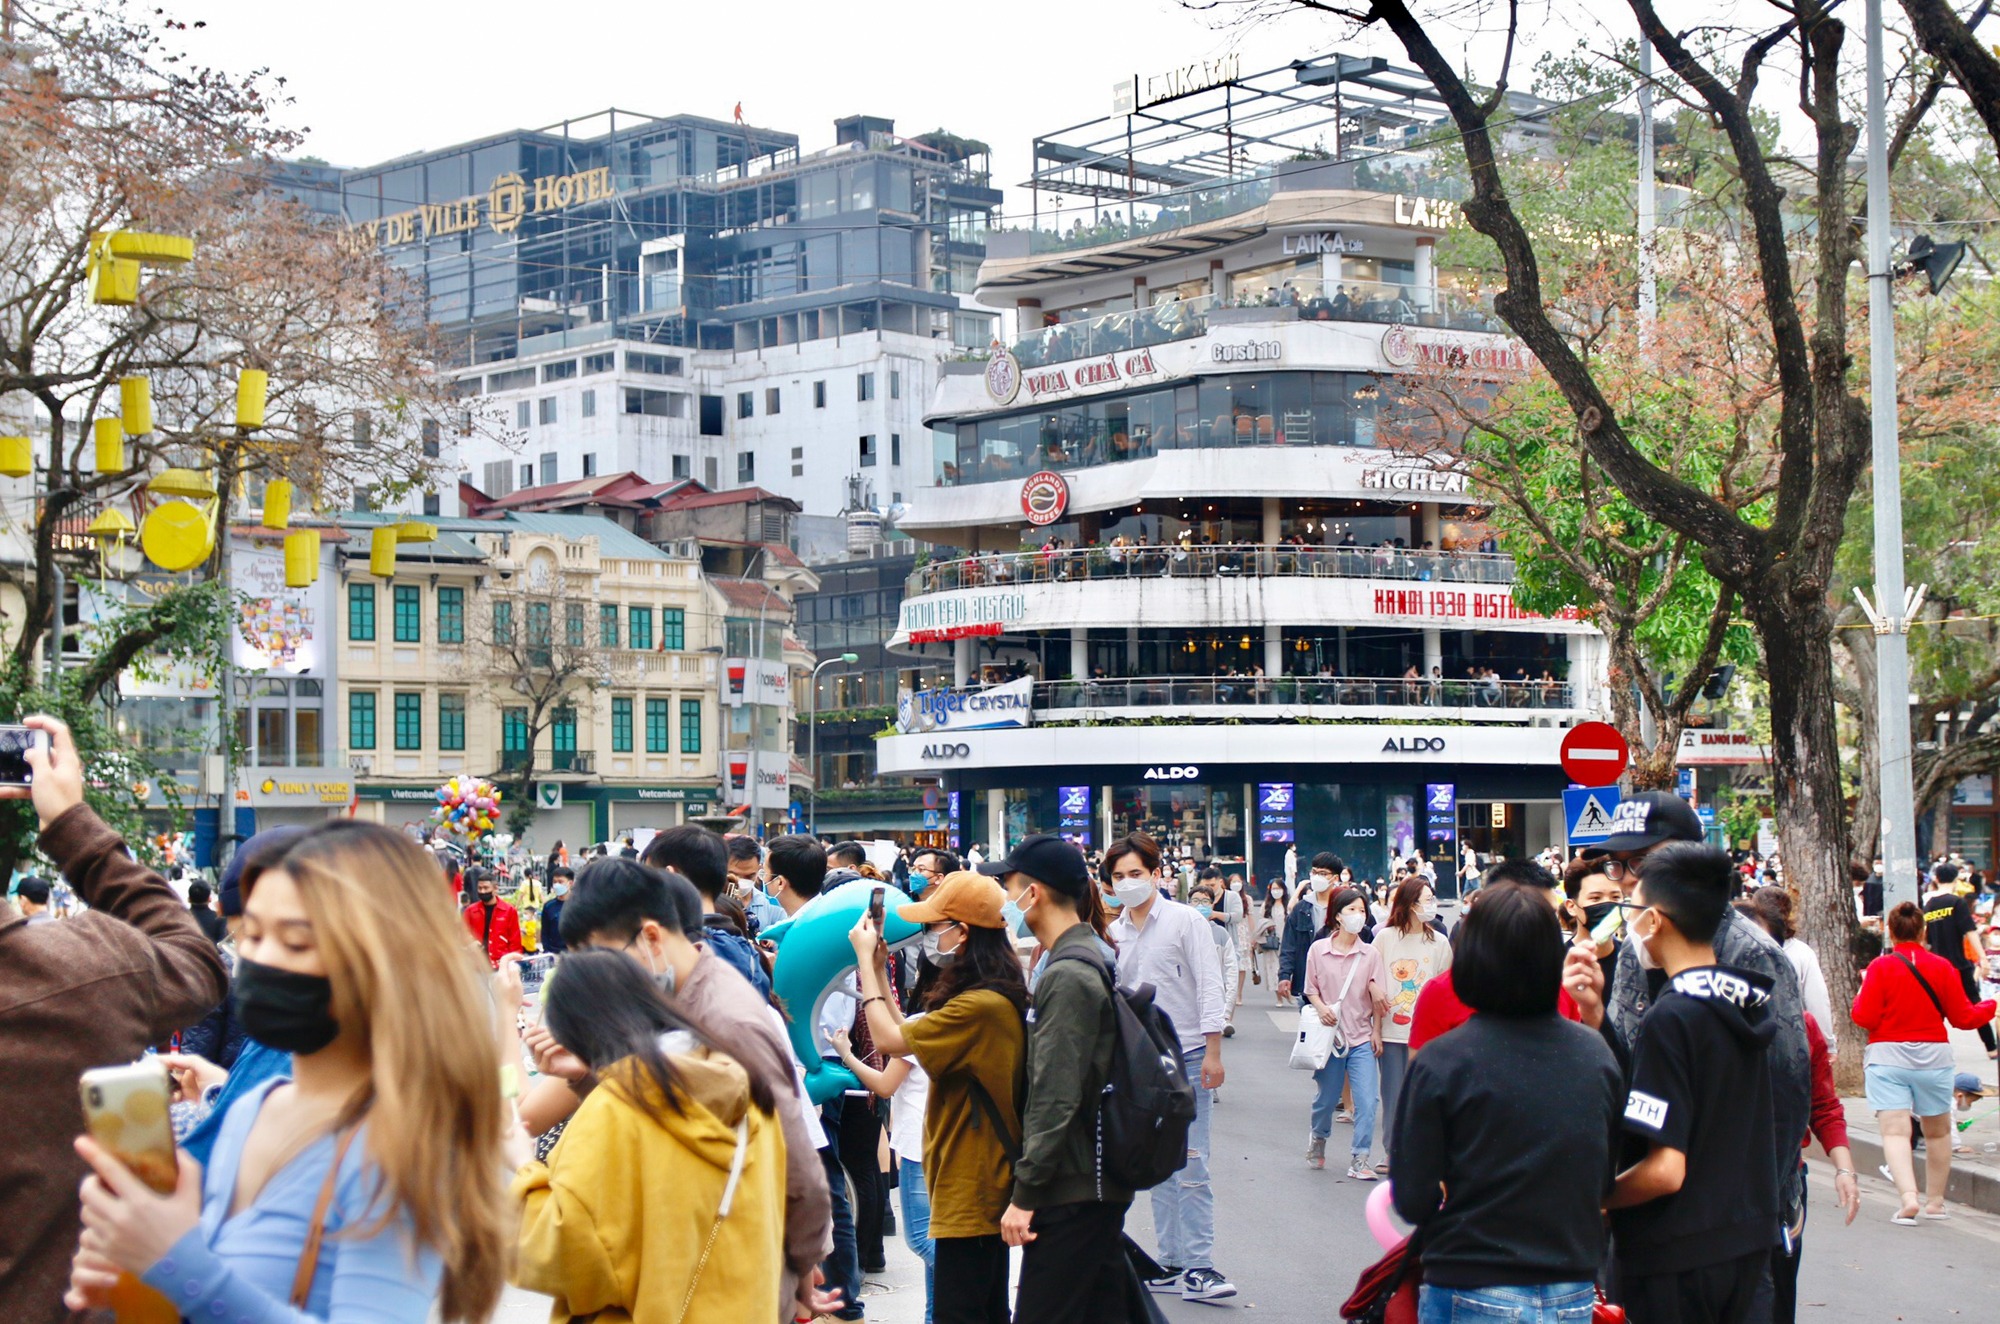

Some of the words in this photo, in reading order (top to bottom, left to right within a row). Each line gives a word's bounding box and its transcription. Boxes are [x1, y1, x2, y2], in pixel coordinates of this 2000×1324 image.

[387, 212, 415, 246] DE
[419, 198, 480, 238] VILLE
[533, 166, 614, 214] HOTEL
[1282, 232, 1346, 255] LAIKA
[1260, 341, 1281, 360] 10
[1026, 370, 1070, 396] VUA
[1022, 474, 1064, 499] HIGHLANDS
[1028, 506, 1060, 522] COFFEE
[1375, 589, 1423, 615] HANOI
[1430, 590, 1466, 617] 1930
[903, 602, 935, 630] HANOI
[938, 597, 967, 624] 1930
[973, 594, 1025, 621] BISTRO
[916, 686, 966, 725] Tiger
[969, 693, 1029, 712] CRYSTAL
[921, 743, 970, 759] ALDO
[1382, 737, 1445, 752] ALDO
[1143, 766, 1199, 779] ALDO
[277, 783, 311, 795] YENLY
[313, 783, 349, 794] YOURS
[391, 789, 437, 799] Vietcomban
[638, 789, 685, 799] Vietcombank
[688, 804, 704, 812] ATM
[1343, 828, 1377, 837] ALDO
[1438, 844, 1446, 855] 1
[1673, 969, 1750, 1009] NEVER
